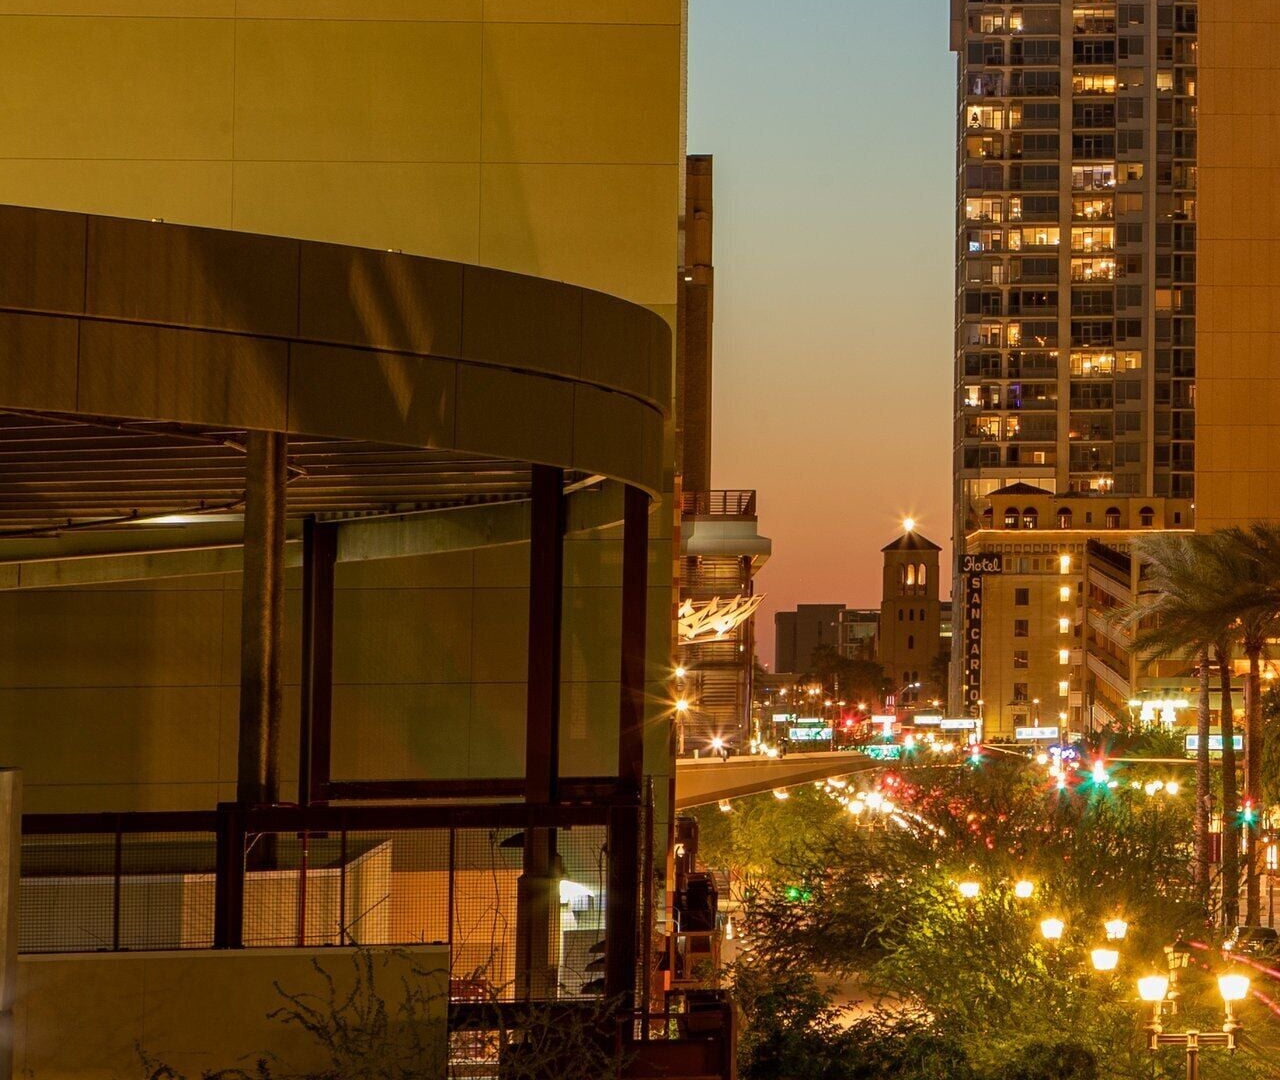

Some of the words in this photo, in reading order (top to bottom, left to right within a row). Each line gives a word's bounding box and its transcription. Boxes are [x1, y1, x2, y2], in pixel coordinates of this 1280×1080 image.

[963, 556, 1001, 572] Hotel
[970, 577, 981, 619] SAN
[969, 628, 982, 718] CARLOS
